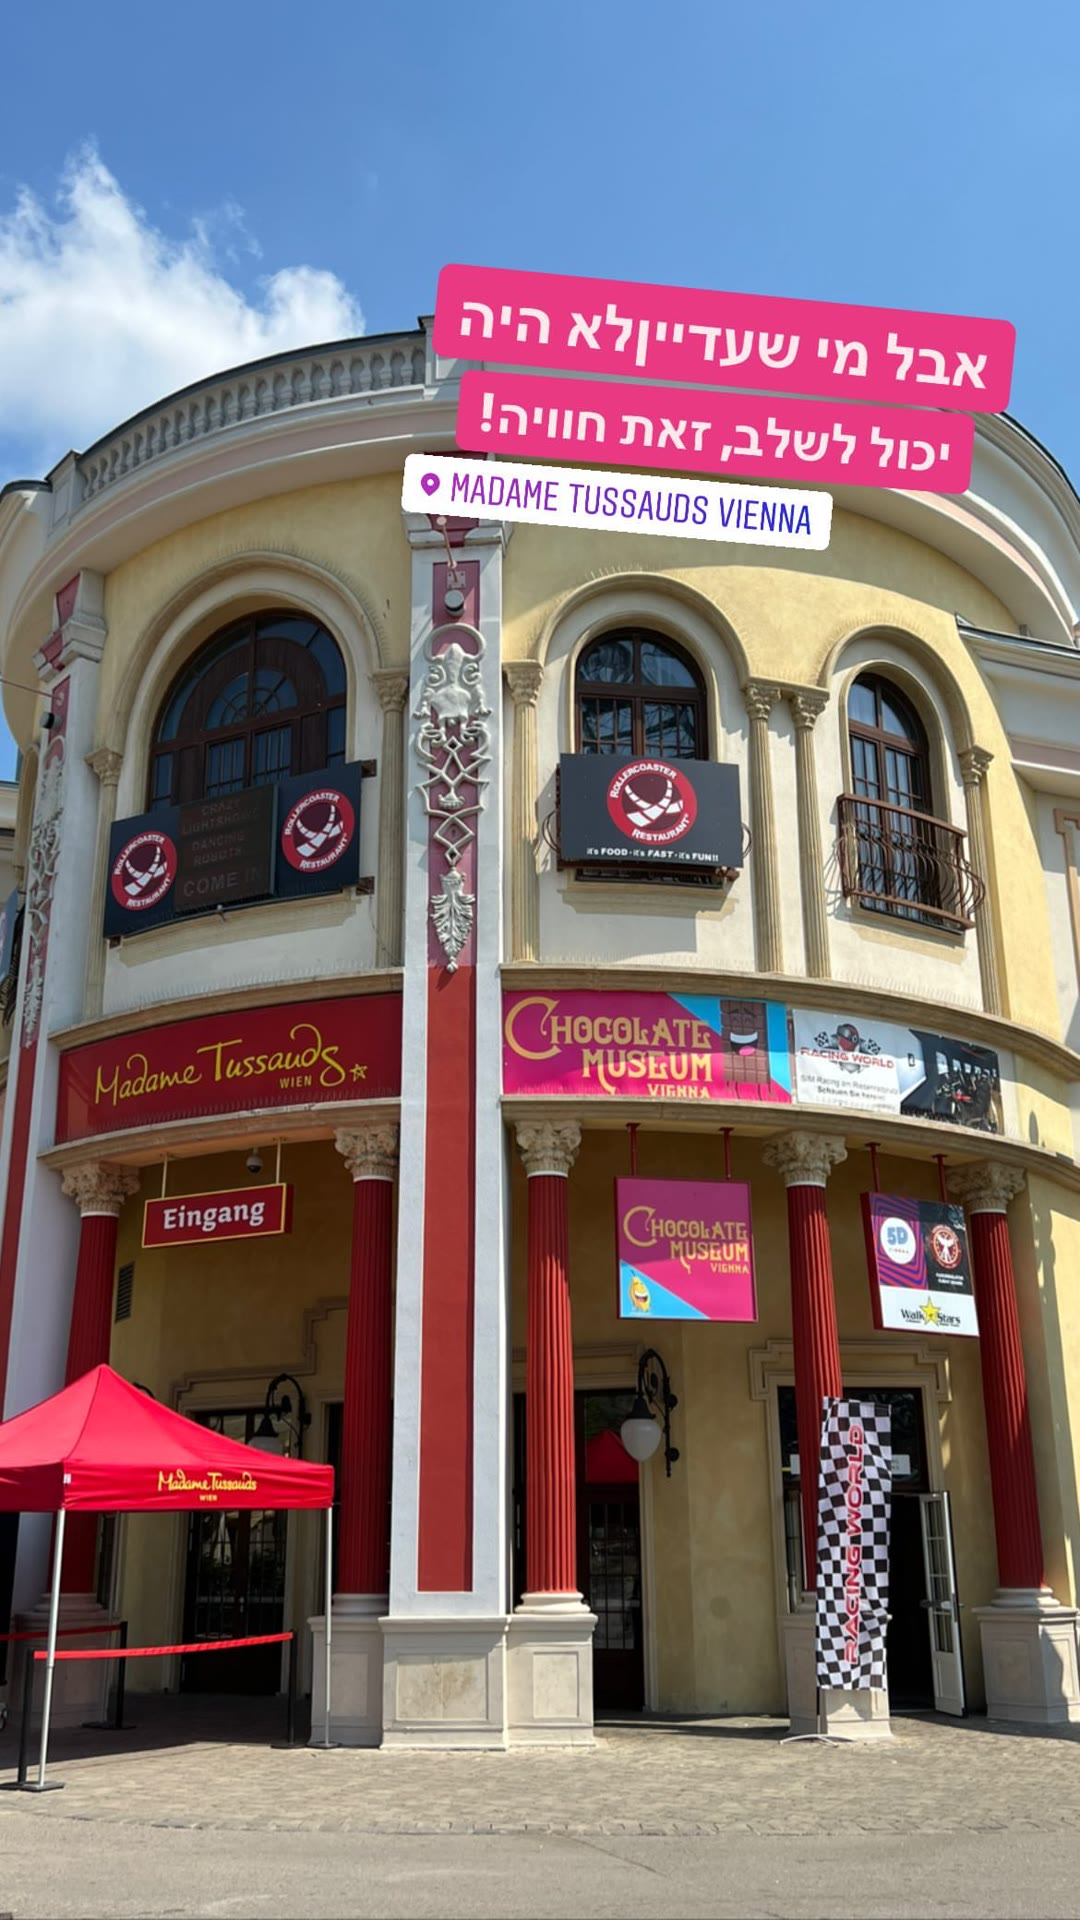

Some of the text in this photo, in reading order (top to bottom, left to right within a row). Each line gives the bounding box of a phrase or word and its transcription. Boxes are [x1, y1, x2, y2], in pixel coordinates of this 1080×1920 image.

[610, 763, 677, 798] ROLLERCOASTER
[284, 791, 340, 836] ROLLERCOASTER
[114, 834, 165, 875] ROLLERCOASTER
[601, 848, 628, 856] FOOD
[647, 850, 674, 859] FAST
[183, 871, 240, 897] COME
[505, 996, 712, 1060] CHOCOLATE
[95, 1023, 346, 1107] Madame Tussauds
[582, 1049, 713, 1096] MUSEUM
[800, 1047, 895, 1069] RACING WORLD
[280, 1075, 313, 1090] WIEN
[647, 1083, 710, 1099] VIENNA
[163, 1202, 265, 1232] Eingang
[623, 1206, 748, 1248] CHOCOLATE
[887, 1226, 909, 1246] 5D
[670, 1241, 749, 1274] MUSEUM
[710, 1262, 750, 1274] VIENNA
[901, 1308, 961, 1325] Walk Stars
[158, 1468, 257, 1491] Madame Tussauds
[844, 1423, 866, 1666] RACING WORLD
